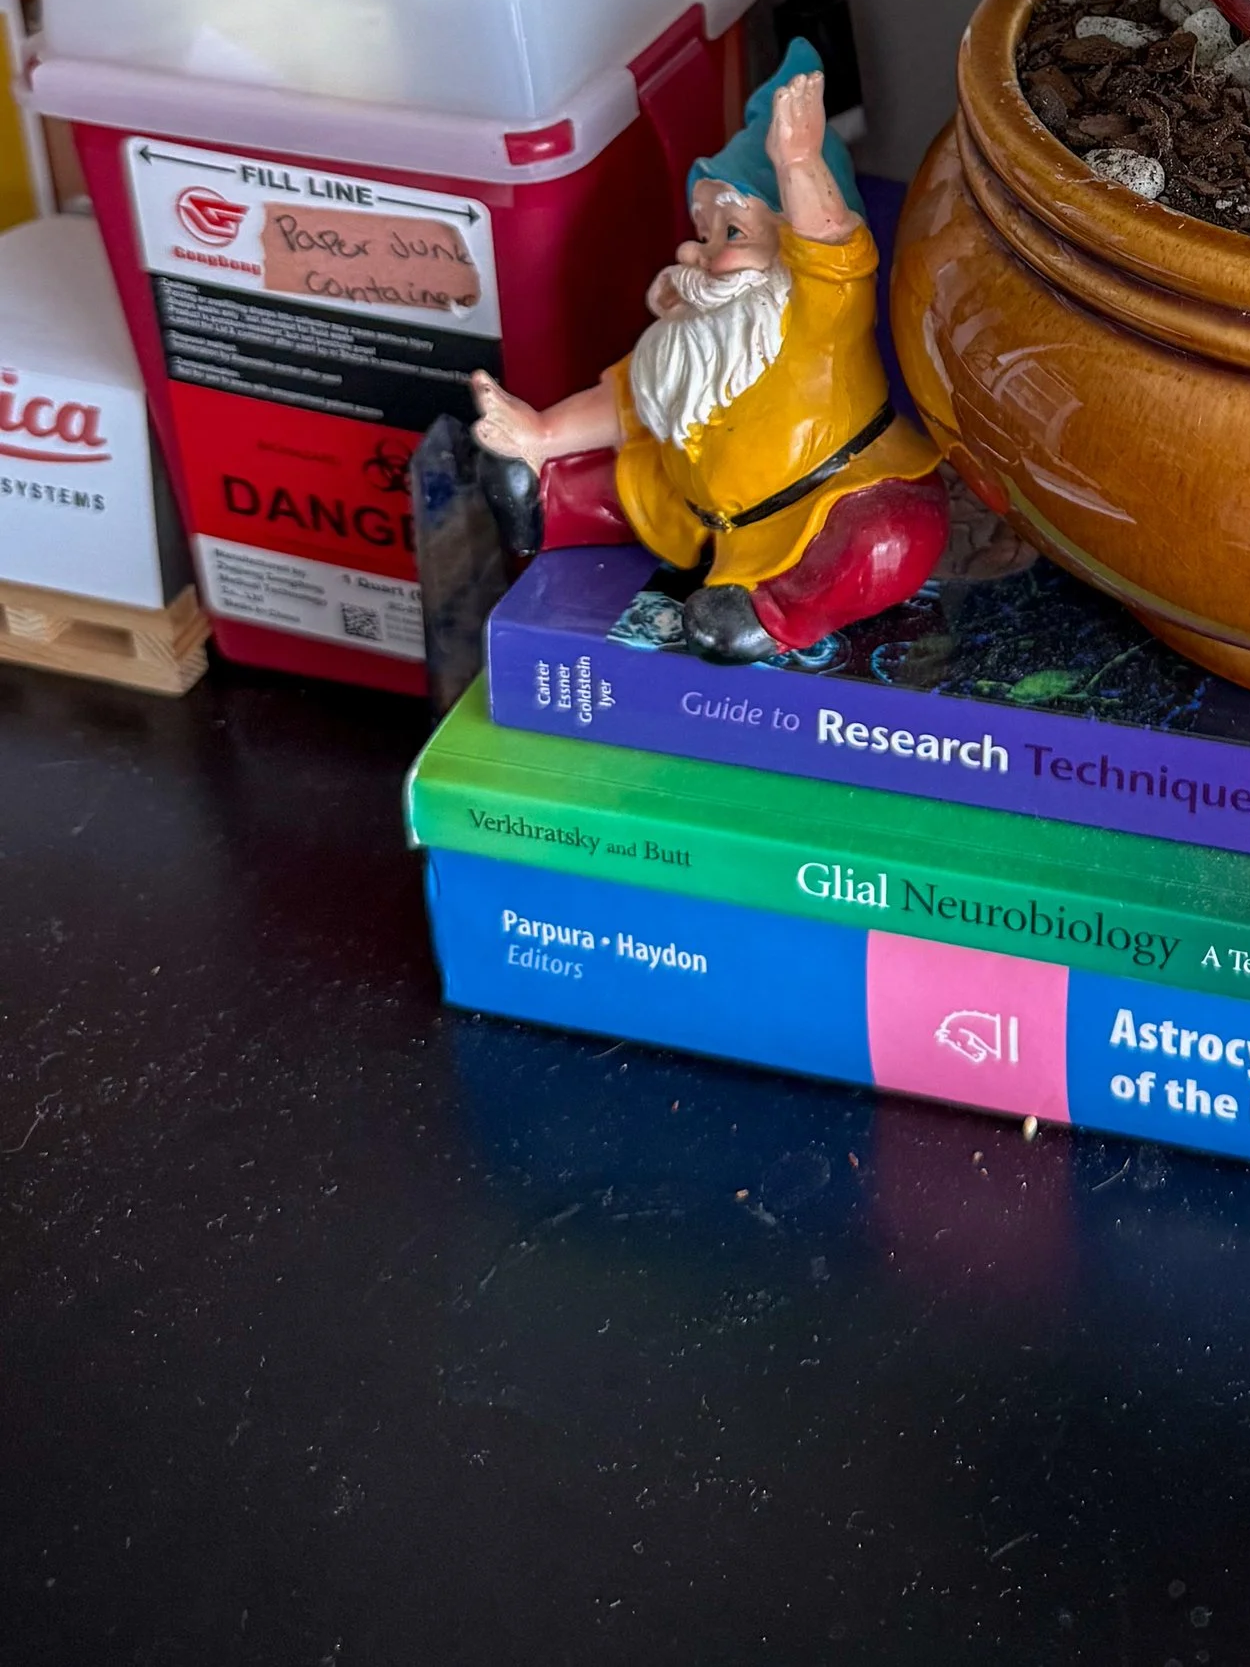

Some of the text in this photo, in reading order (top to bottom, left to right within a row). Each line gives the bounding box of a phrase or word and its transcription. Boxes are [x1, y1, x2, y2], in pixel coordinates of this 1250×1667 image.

[240, 164, 374, 206] FILL LINE
[1, 477, 106, 511] SYSTEMS
[537, 660, 551, 707] Carter
[558, 663, 571, 710] Essner
[576, 655, 592, 724] Goldstein
[681, 691, 763, 725] Guide
[772, 707, 800, 731] to
[817, 708, 1009, 773] Research
[468, 808, 693, 867] Verkhratsky and Butt
[797, 862, 890, 909] Glial
[901, 879, 1182, 970] Neurobiology
[1201, 946, 1222, 971] A
[503, 909, 707, 974] Parpura Haydon
[507, 944, 584, 980] Editors
[1110, 1071, 1156, 1104] of
[1164, 1079, 1238, 1119] the
